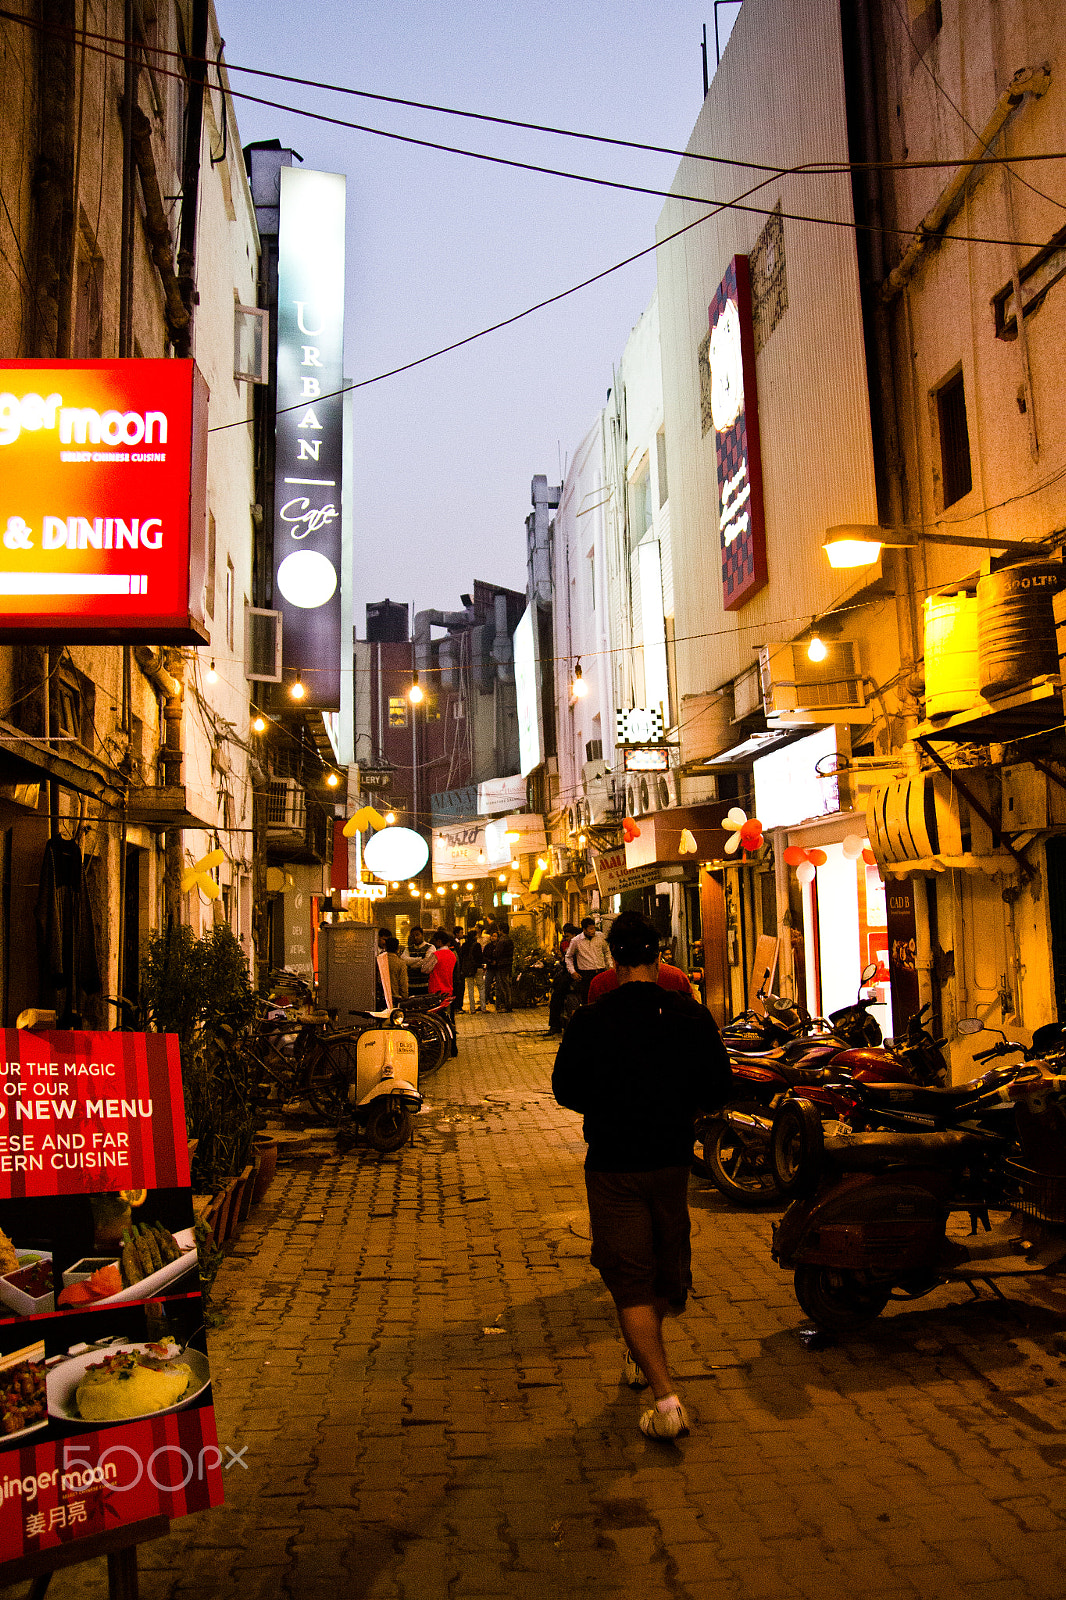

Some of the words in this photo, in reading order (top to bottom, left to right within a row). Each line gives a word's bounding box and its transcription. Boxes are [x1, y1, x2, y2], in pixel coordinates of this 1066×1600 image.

[293, 300, 325, 461] URBAN
[59, 407, 168, 445] moon
[92, 452, 130, 462] CHINESE
[131, 453, 166, 462] CUISINE
[280, 497, 339, 539] Cafe
[3, 516, 34, 549] &
[42, 516, 163, 549] DINING
[889, 896, 904, 909] CAD
[26, 1063, 59, 1076] THE
[64, 1063, 116, 1076] MAGIC
[4, 1083, 27, 1095] OF
[33, 1083, 69, 1096] OUR
[15, 1100, 77, 1120] NEW
[86, 1099, 153, 1118] MENU
[0, 1135, 34, 1152] ESE
[42, 1133, 85, 1150] AND
[92, 1132, 129, 1149] FAR
[1, 1154, 43, 1172] ERN
[50, 1151, 129, 1170] CUISINE
[0, 1468, 59, 1507] inger
[61, 1462, 117, 1491] moon
[25, 1500, 88, 1538] 姜月亮
